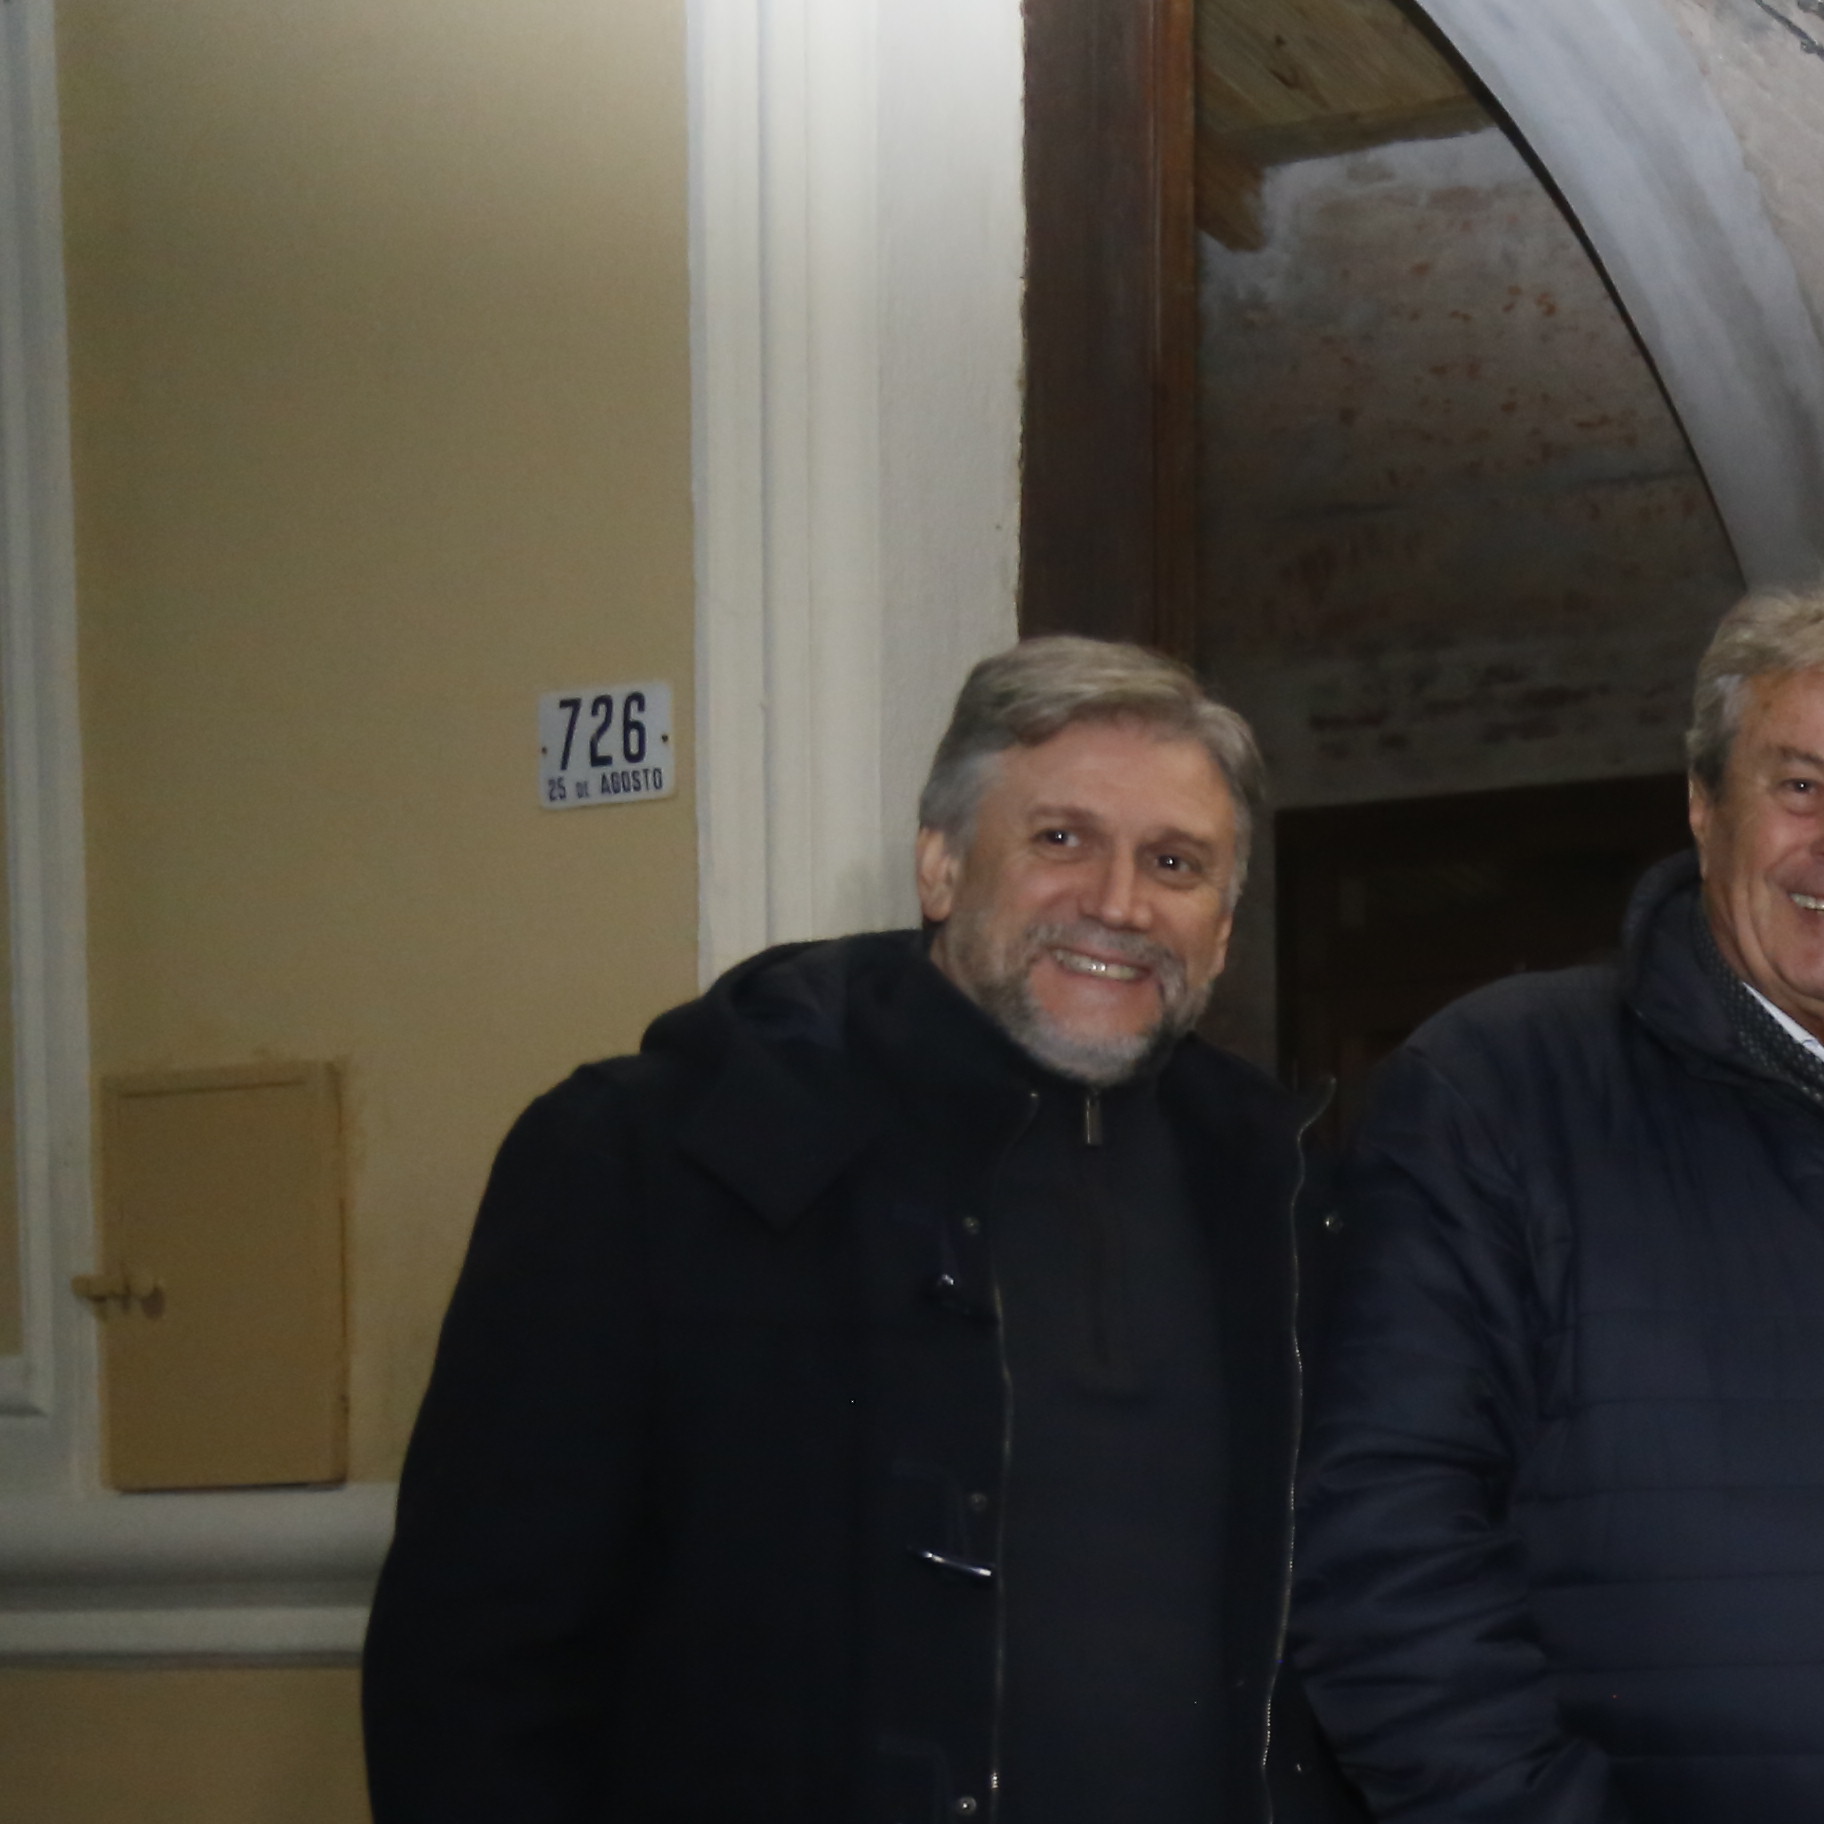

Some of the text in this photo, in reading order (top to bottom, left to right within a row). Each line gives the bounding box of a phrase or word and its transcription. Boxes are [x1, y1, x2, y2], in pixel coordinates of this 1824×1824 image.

[558, 691, 647, 771] 726
[548, 767, 664, 802] 25 DE AGOSTO
